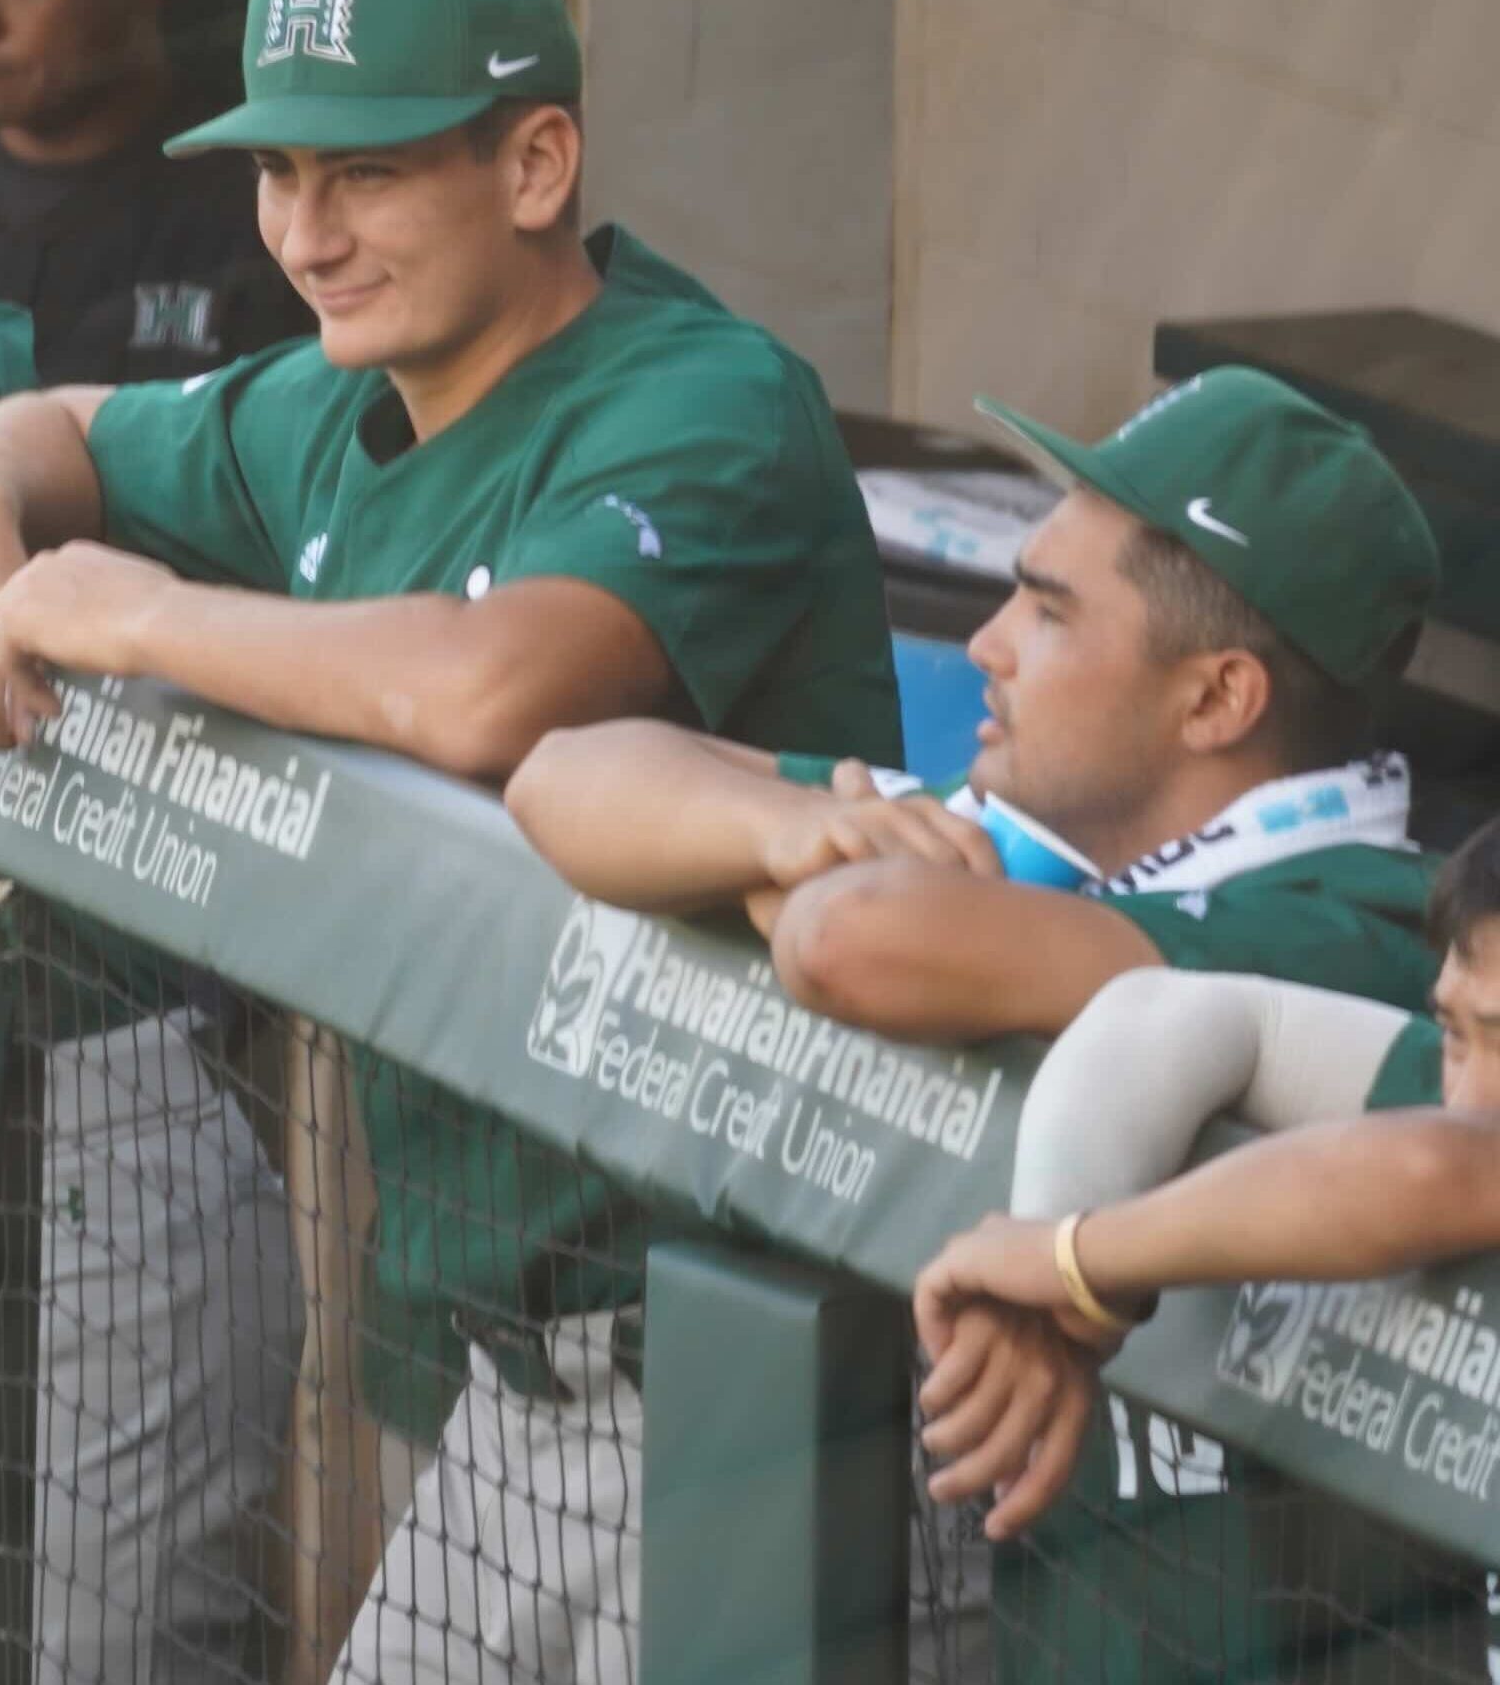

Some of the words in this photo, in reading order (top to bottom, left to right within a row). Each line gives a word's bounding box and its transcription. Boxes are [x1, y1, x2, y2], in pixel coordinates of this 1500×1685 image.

[127, 281, 221, 351] H
[53, 771, 138, 870] Credit
[133, 804, 218, 907] Union
[150, 713, 332, 862] Financial
[612, 918, 812, 1077] Hawaiian
[592, 1009, 703, 1121] Federal
[689, 1057, 783, 1161] Credit
[781, 1096, 876, 1204] Union
[1284, 1337, 1415, 1454] Federal
